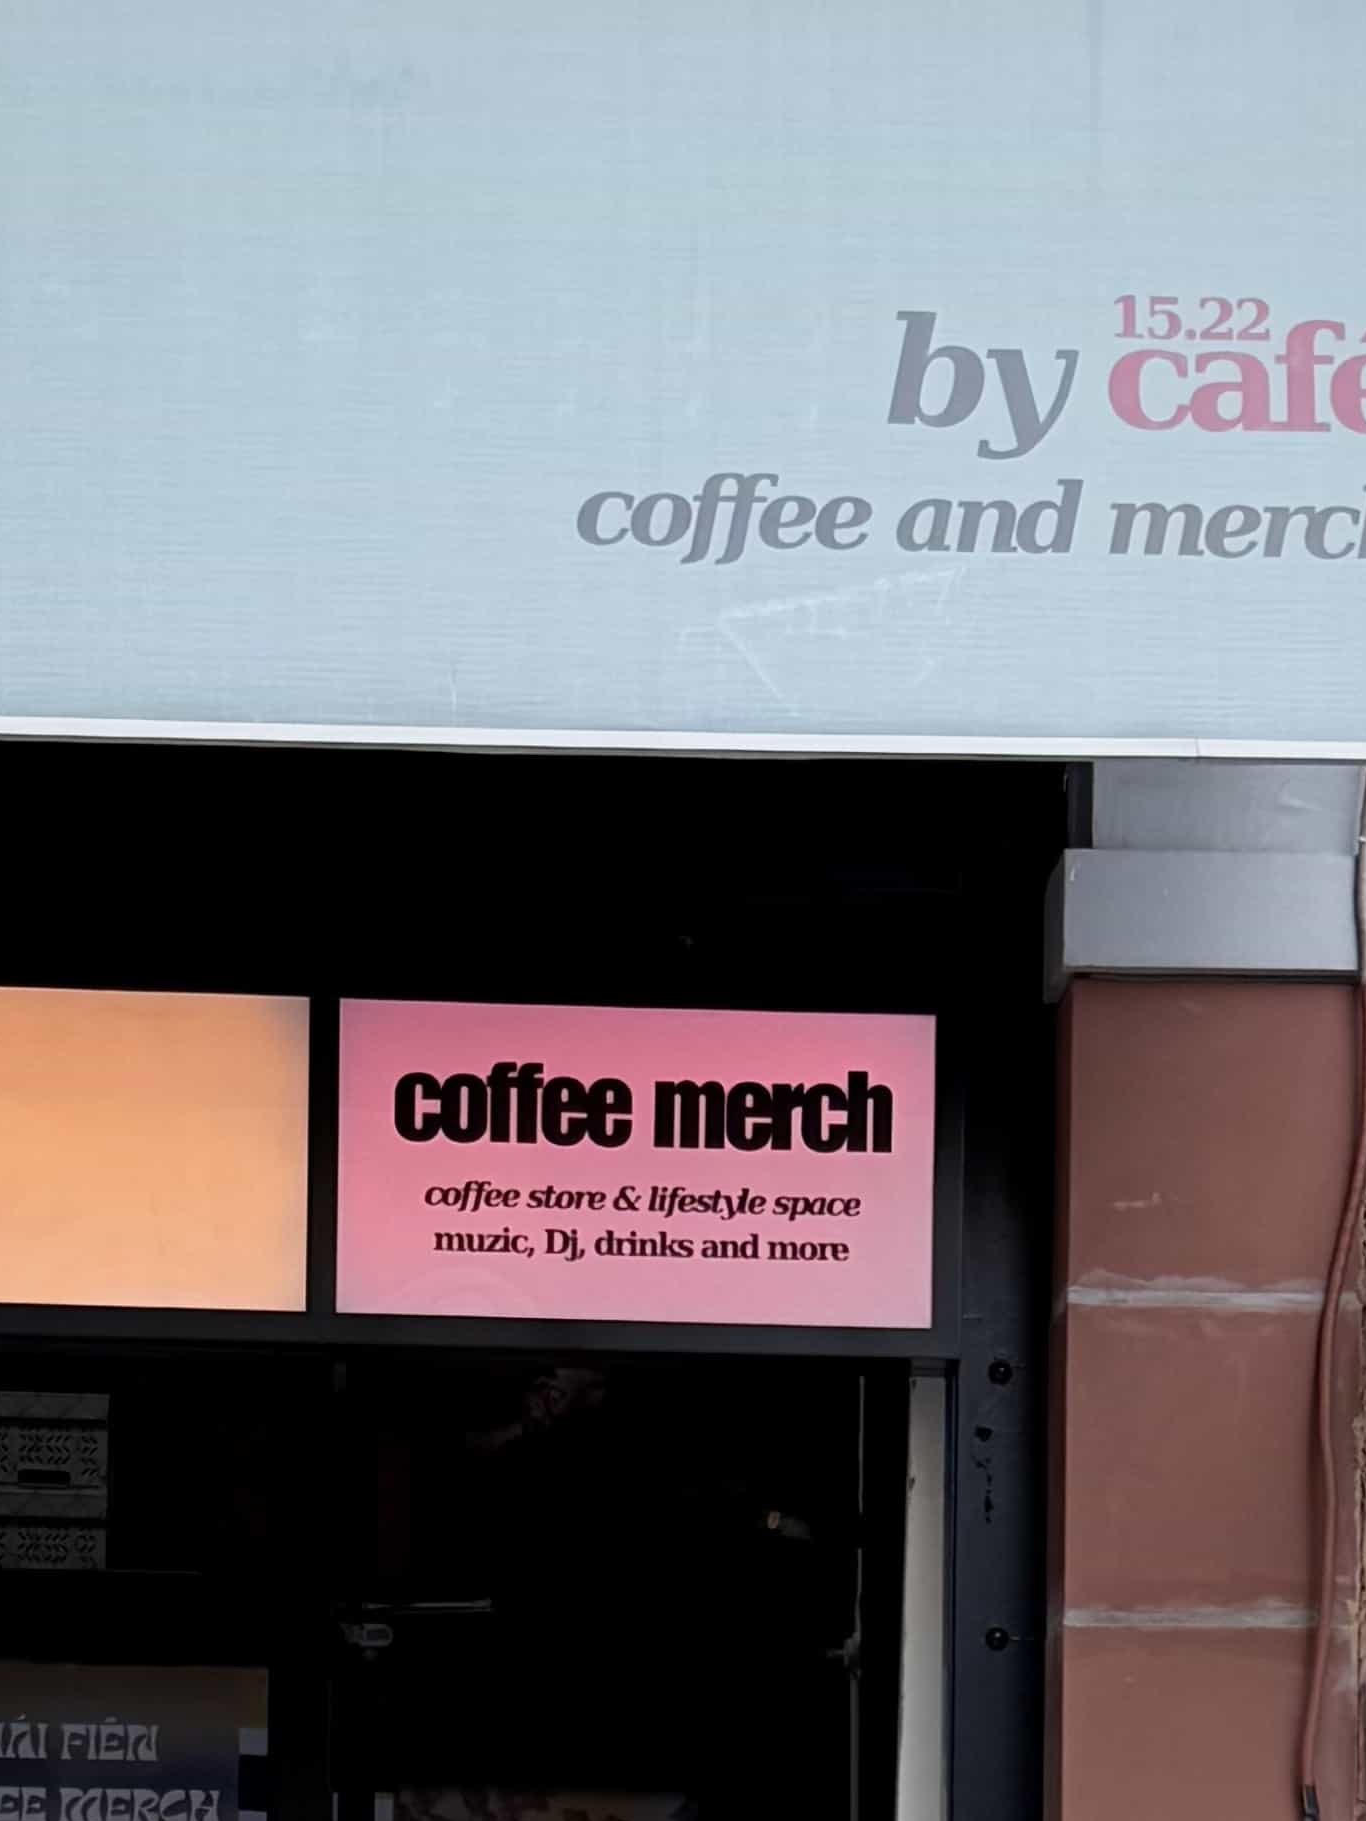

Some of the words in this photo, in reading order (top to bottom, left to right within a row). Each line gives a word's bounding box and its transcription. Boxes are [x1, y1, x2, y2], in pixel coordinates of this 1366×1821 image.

[887, 311, 1079, 460] by
[1112, 294, 1271, 342] 15.22
[576, 472, 872, 565] coffee
[896, 479, 1083, 554] and
[394, 1062, 633, 1147] coffee
[653, 1071, 893, 1153] merch
[424, 1180, 520, 1212] coffee
[527, 1185, 606, 1210] store
[613, 1186, 640, 1211] &
[648, 1186, 766, 1220] lifestyle
[772, 1192, 861, 1221] space
[433, 1227, 534, 1258] muzic,
[544, 1228, 585, 1261] Dj,
[594, 1230, 694, 1258] drinks
[701, 1233, 760, 1260] and
[766, 1239, 850, 1261] more
